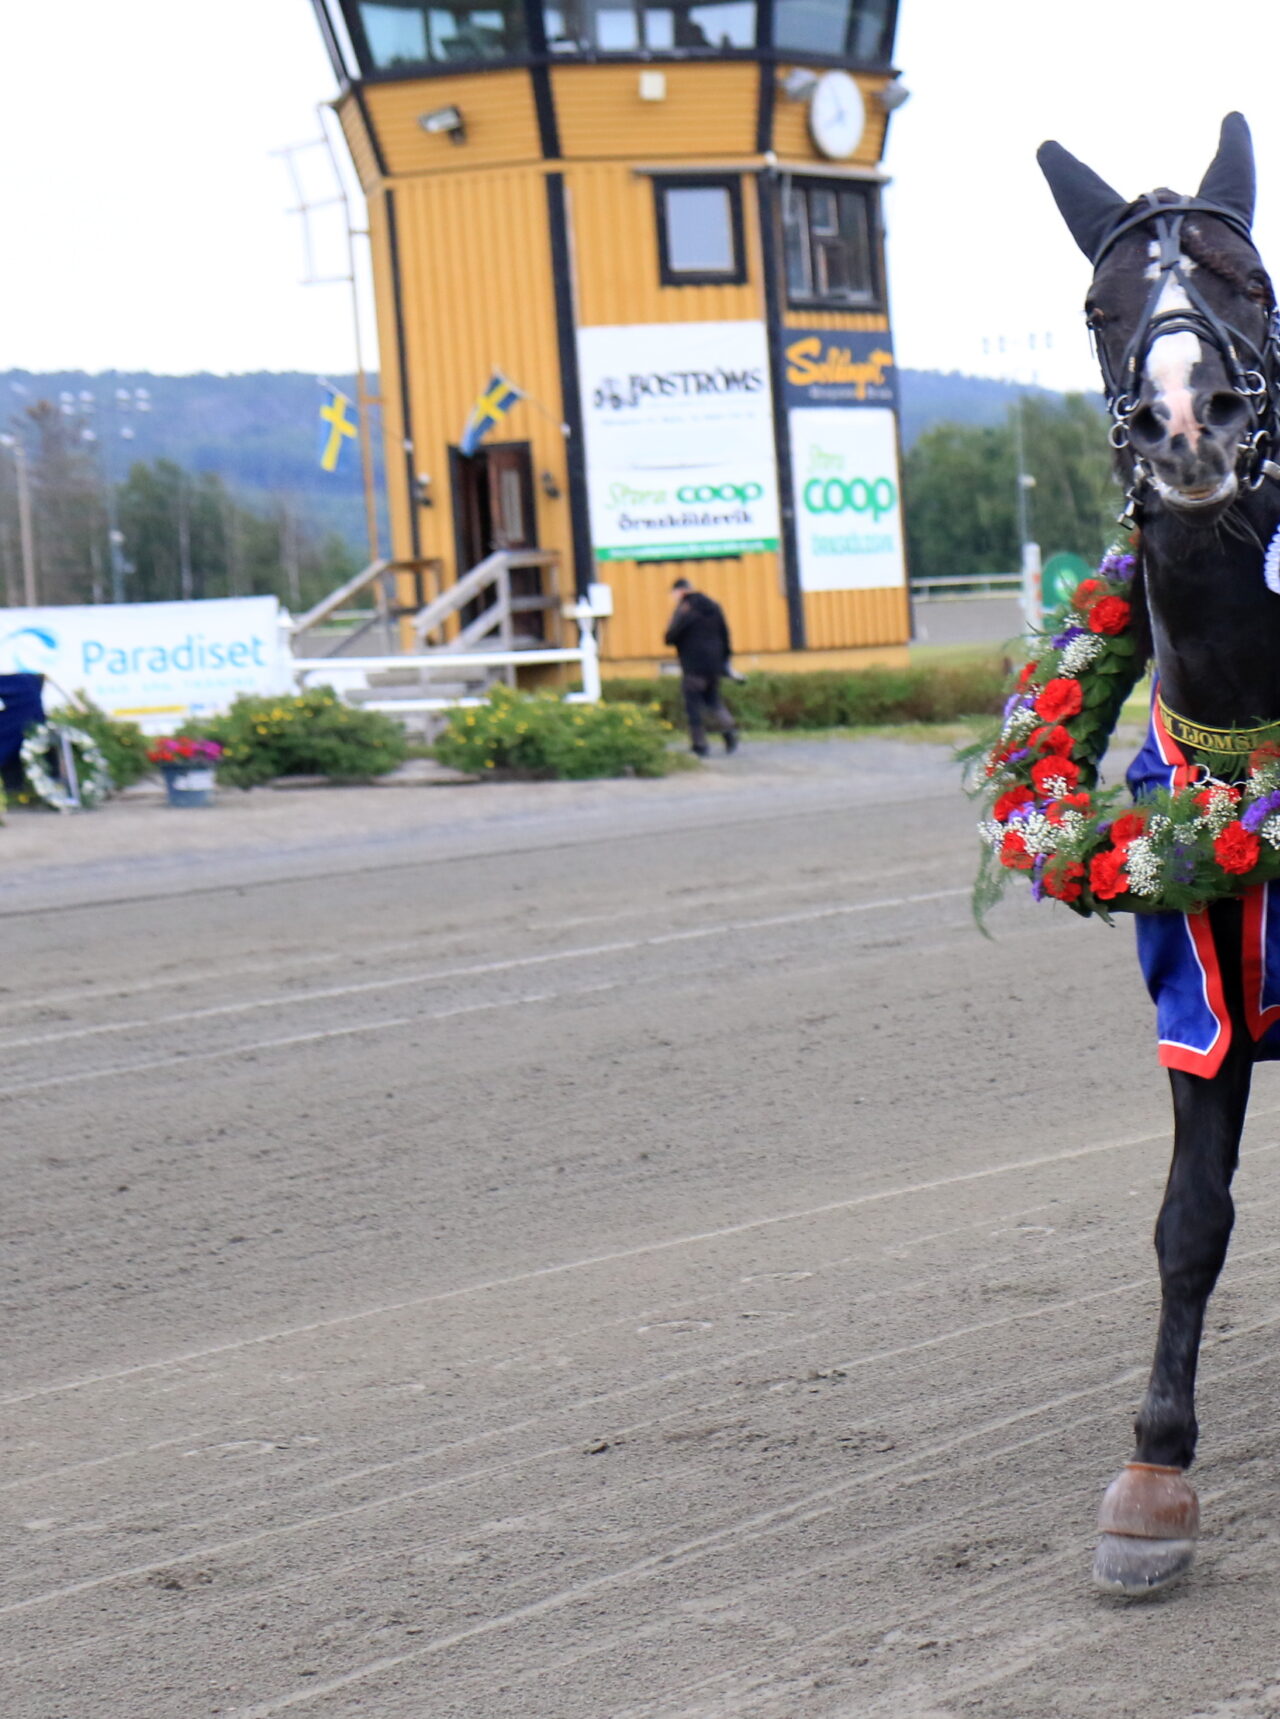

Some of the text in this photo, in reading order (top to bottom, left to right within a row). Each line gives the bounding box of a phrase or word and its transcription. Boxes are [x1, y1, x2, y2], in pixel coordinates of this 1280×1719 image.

[677, 482, 763, 505] coop
[803, 476, 896, 523] coop
[81, 633, 267, 675] Paradiset
